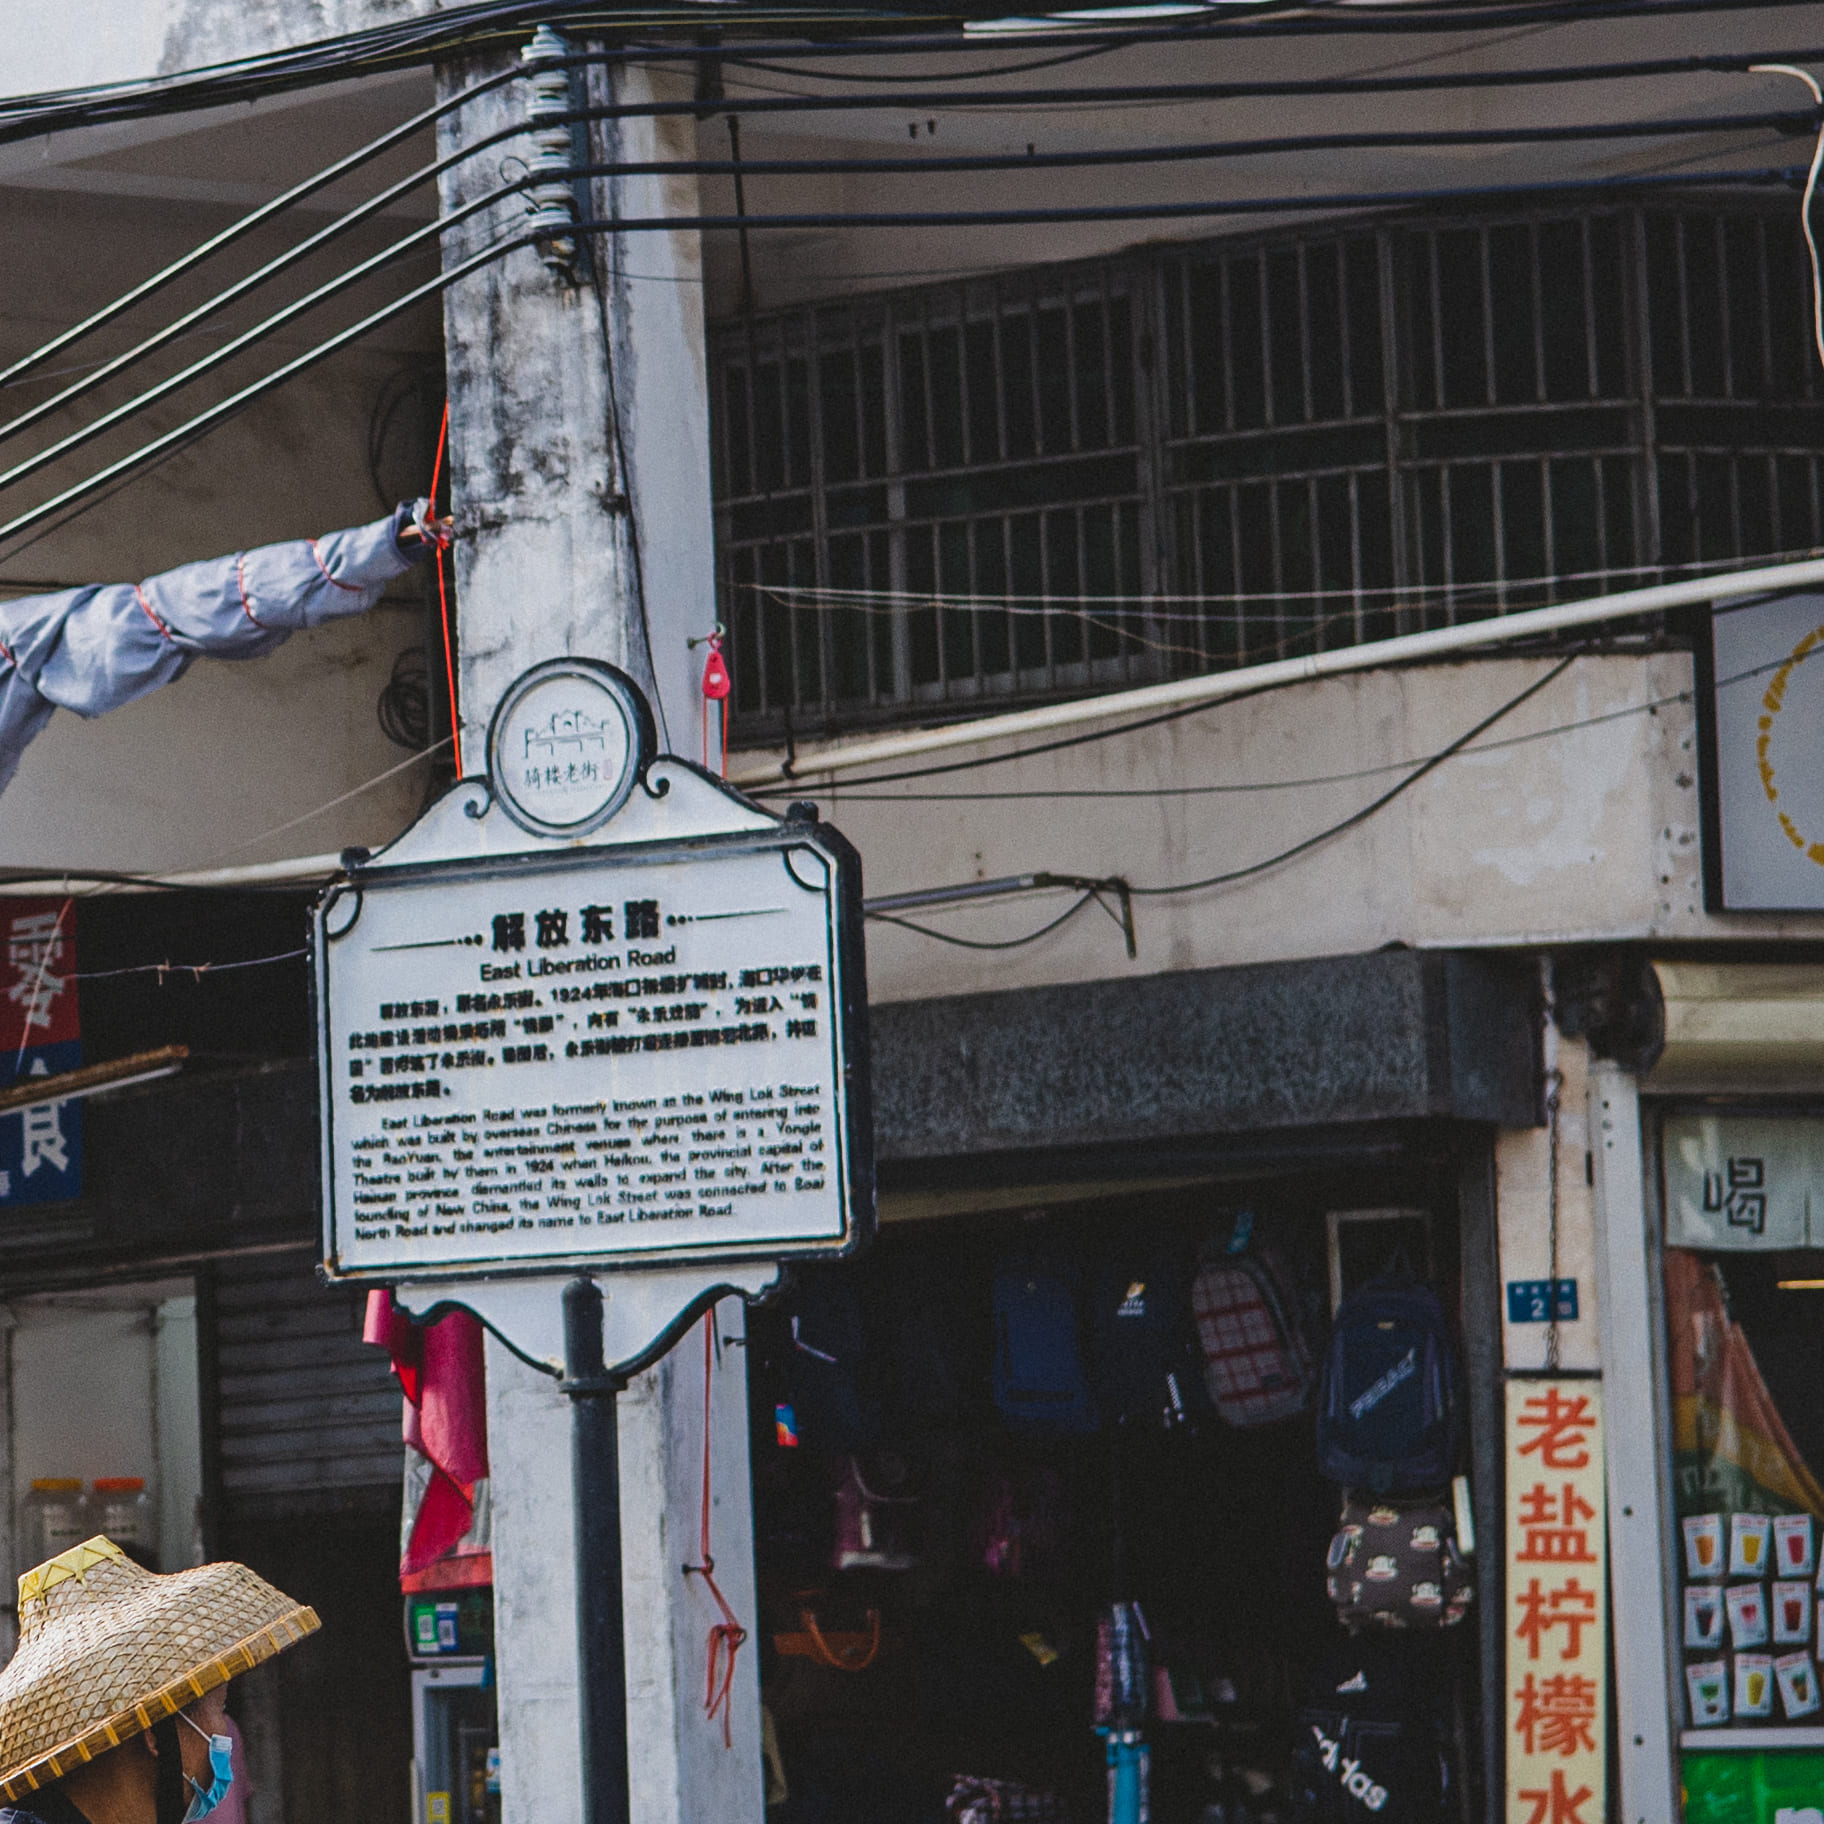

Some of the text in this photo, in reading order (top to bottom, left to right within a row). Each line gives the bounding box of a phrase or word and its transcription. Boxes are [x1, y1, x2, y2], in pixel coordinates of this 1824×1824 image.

[491, 899, 661, 953] 解放东路
[480, 944, 676, 982] East Liberation Road
[350, 1136, 390, 1151] which
[396, 1135, 422, 1147] was
[427, 1129, 457, 1145] built
[461, 1129, 480, 1145] by
[483, 1127, 541, 1141] overseas
[603, 1117, 622, 1131] for
[627, 1116, 649, 1130] the
[654, 1112, 708, 1130] purpose
[713, 1108, 728, 1123] of
[732, 1107, 789, 1124] entering
[794, 1103, 821, 1117] into
[381, 1084, 821, 1131] East Liberation Road was formerly known as the Wing Lok Street
[351, 1155, 373, 1169] the
[452, 1149, 474, 1162] the
[691, 1129, 726, 1142] there
[736, 1129, 747, 1139] is
[757, 1128, 765, 1138] a
[353, 1172, 402, 1186] Theatre
[407, 1167, 436, 1183] built
[442, 1167, 459, 1181] by
[464, 1165, 499, 1178] them
[505, 1163, 517, 1175] in
[525, 1159, 555, 1174] 1924
[560, 1159, 598, 1171] when
[659, 1150, 681, 1163] the
[687, 1144, 752, 1162] provincial
[809, 1138, 825, 1152] of
[353, 1191, 397, 1205] Hainan
[405, 1188, 460, 1202] province
[551, 1178, 567, 1191] its
[574, 1173, 609, 1189] walls
[616, 1174, 630, 1186] to
[638, 1168, 687, 1186] expand
[693, 1166, 716, 1180] the
[760, 1160, 794, 1175] After
[801, 1158, 824, 1172] the
[417, 1205, 430, 1218] of
[435, 1203, 465, 1217] New
[519, 1199, 540, 1211] the
[546, 1195, 582, 1211] Wing
[587, 1192, 611, 1207] Lok
[617, 1188, 658, 1204] Street
[664, 1189, 692, 1200] was
[773, 1180, 787, 1193] to
[354, 1227, 391, 1241] North
[394, 1223, 429, 1239] Road
[431, 1221, 457, 1237] and
[517, 1217, 535, 1230] its
[537, 1216, 575, 1229] name
[578, 1213, 593, 1226] to
[596, 1210, 626, 1225] East
[628, 1207, 694, 1223] Liberation
